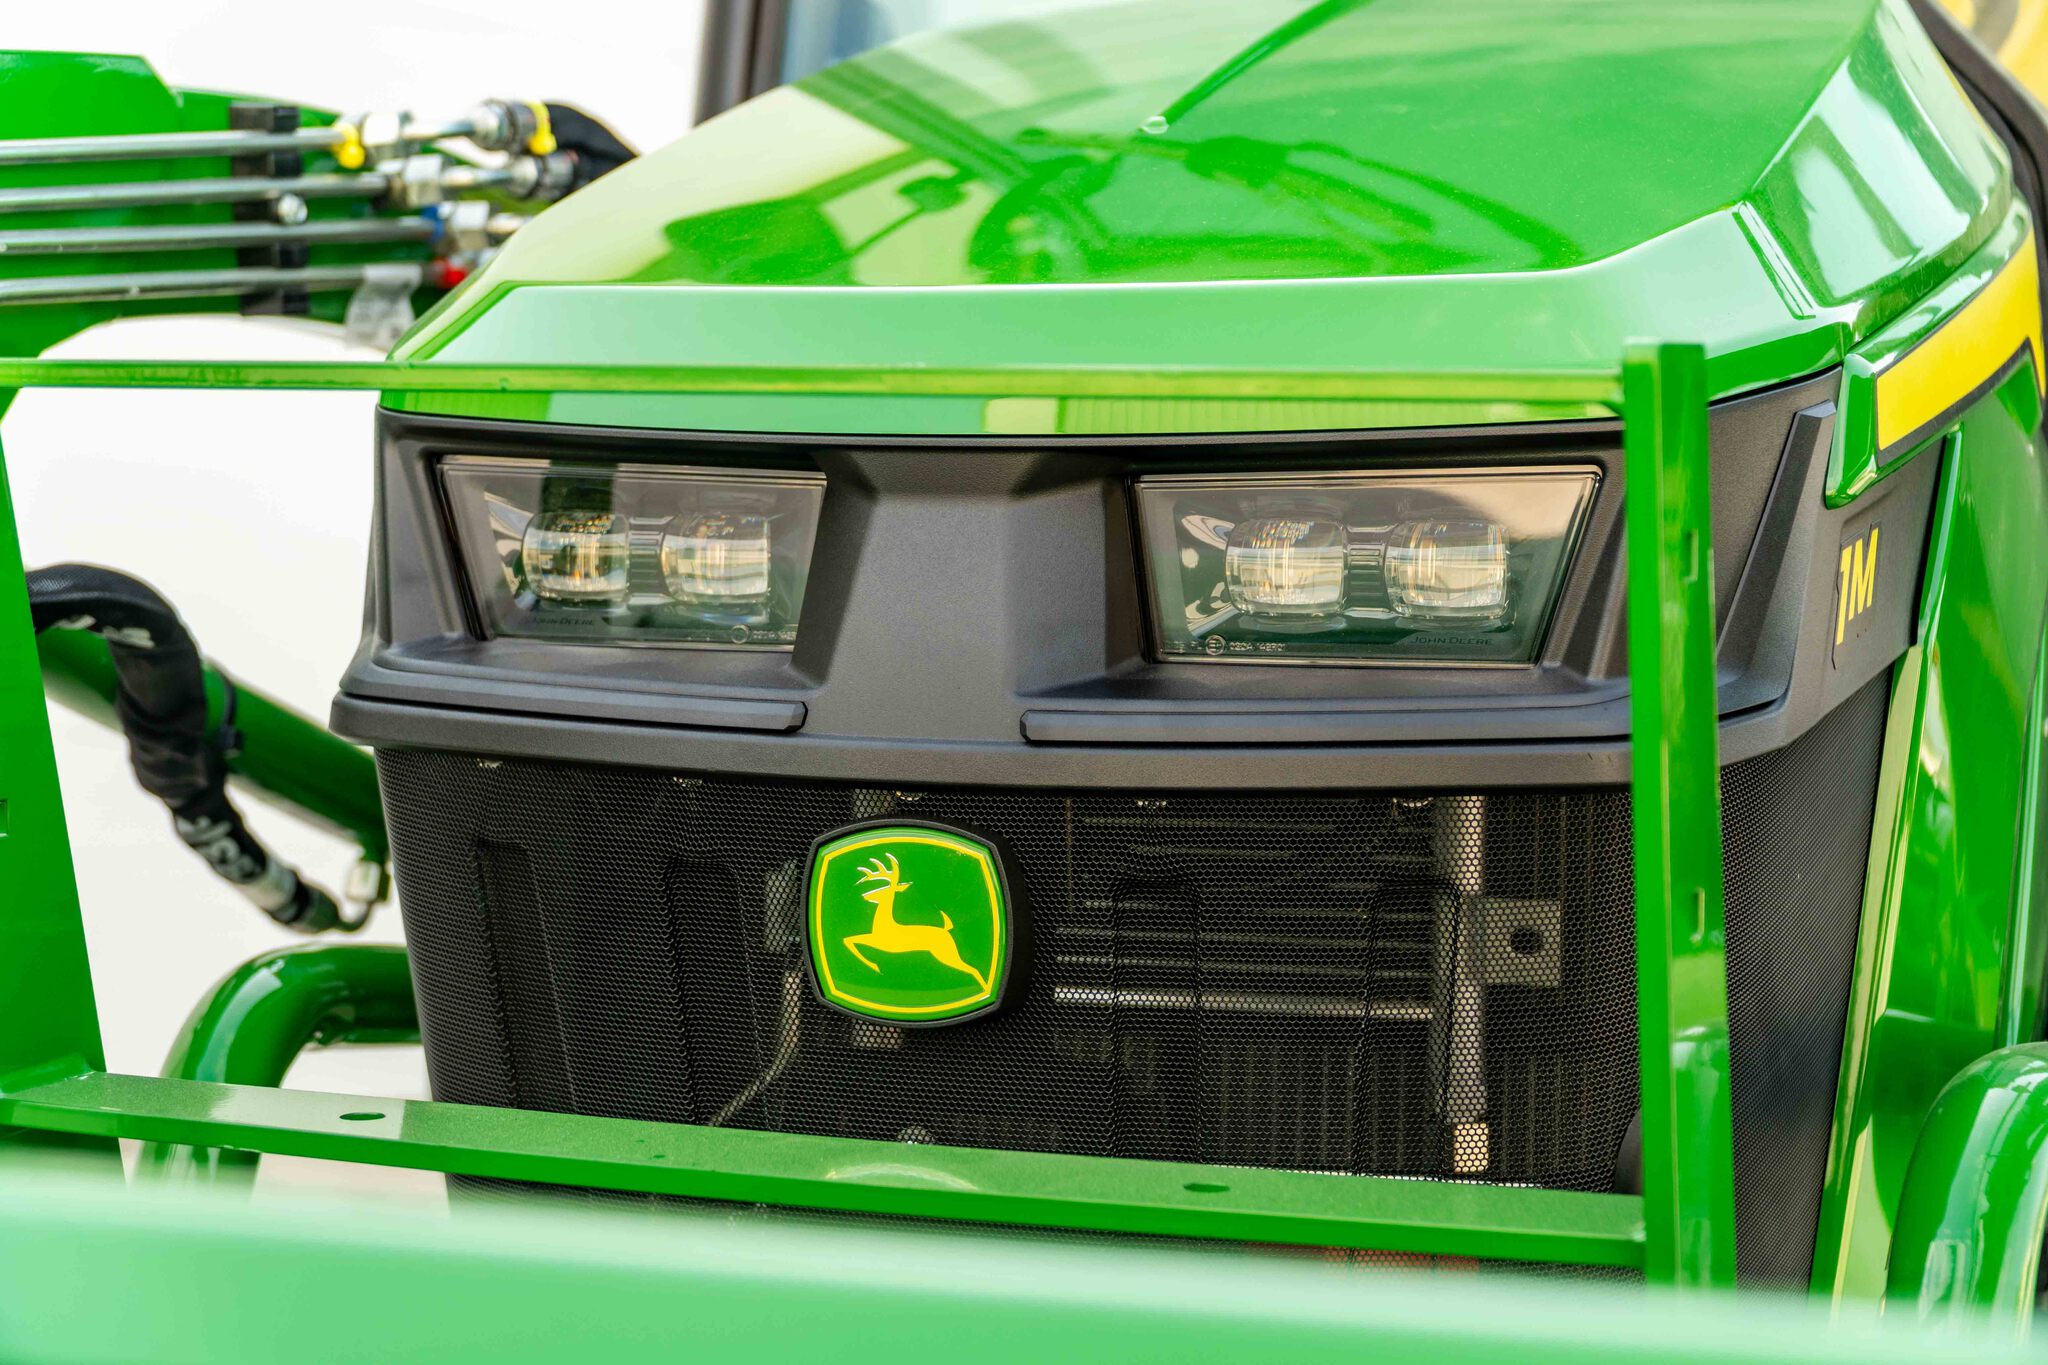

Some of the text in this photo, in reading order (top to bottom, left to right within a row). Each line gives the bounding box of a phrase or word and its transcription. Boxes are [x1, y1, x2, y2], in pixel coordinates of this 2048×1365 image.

[1836, 527, 1879, 646] 1M
[1411, 636, 1493, 646] JOHN DEERE
